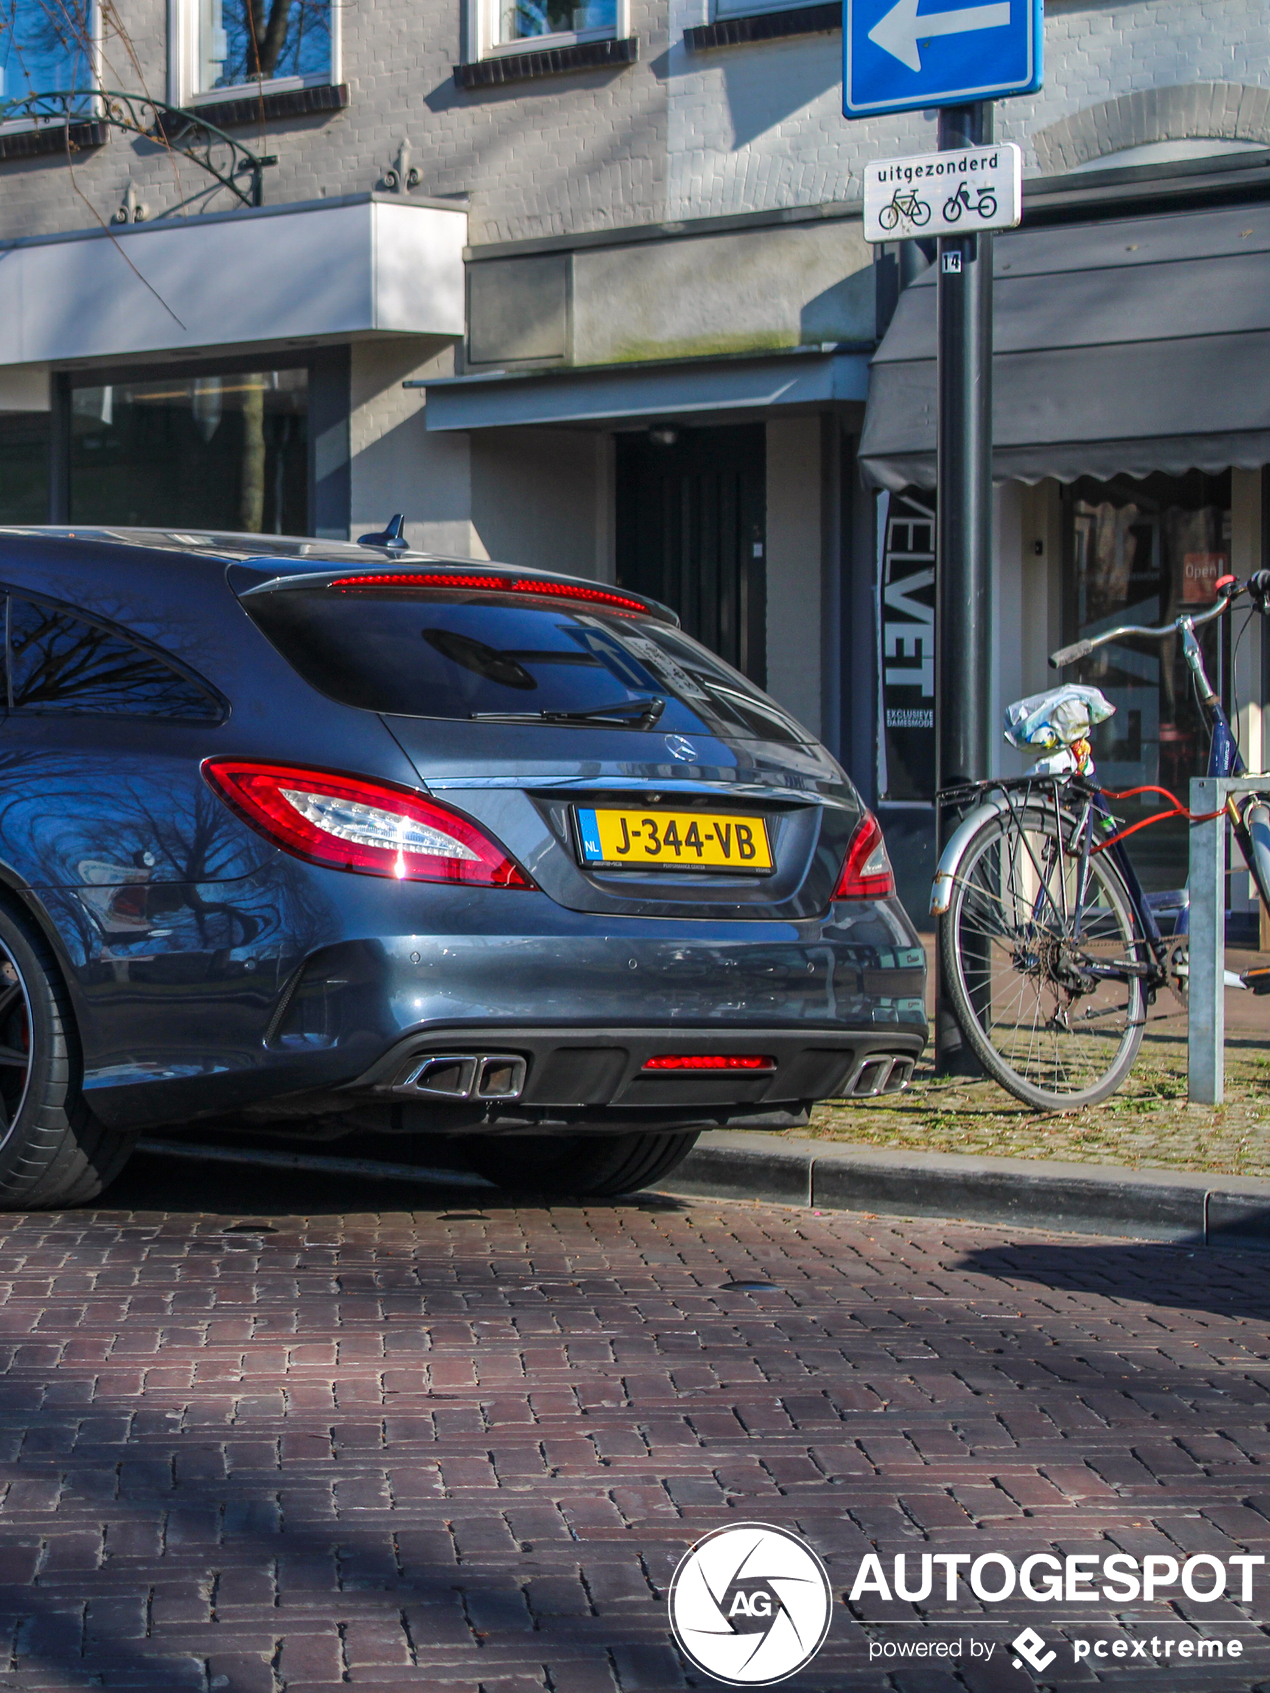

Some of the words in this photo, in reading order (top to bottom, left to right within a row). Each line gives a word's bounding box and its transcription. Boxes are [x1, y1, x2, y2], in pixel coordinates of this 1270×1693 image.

[878, 153, 998, 184] uitgezonderd
[943, 254, 960, 271] 14
[1185, 562, 1217, 581] Open
[886, 708, 934, 719] EXCLUSIEVE
[886, 719, 934, 728] DAMESMODE
[584, 841, 599, 853] NL
[616, 817, 757, 860] J-344-VB
